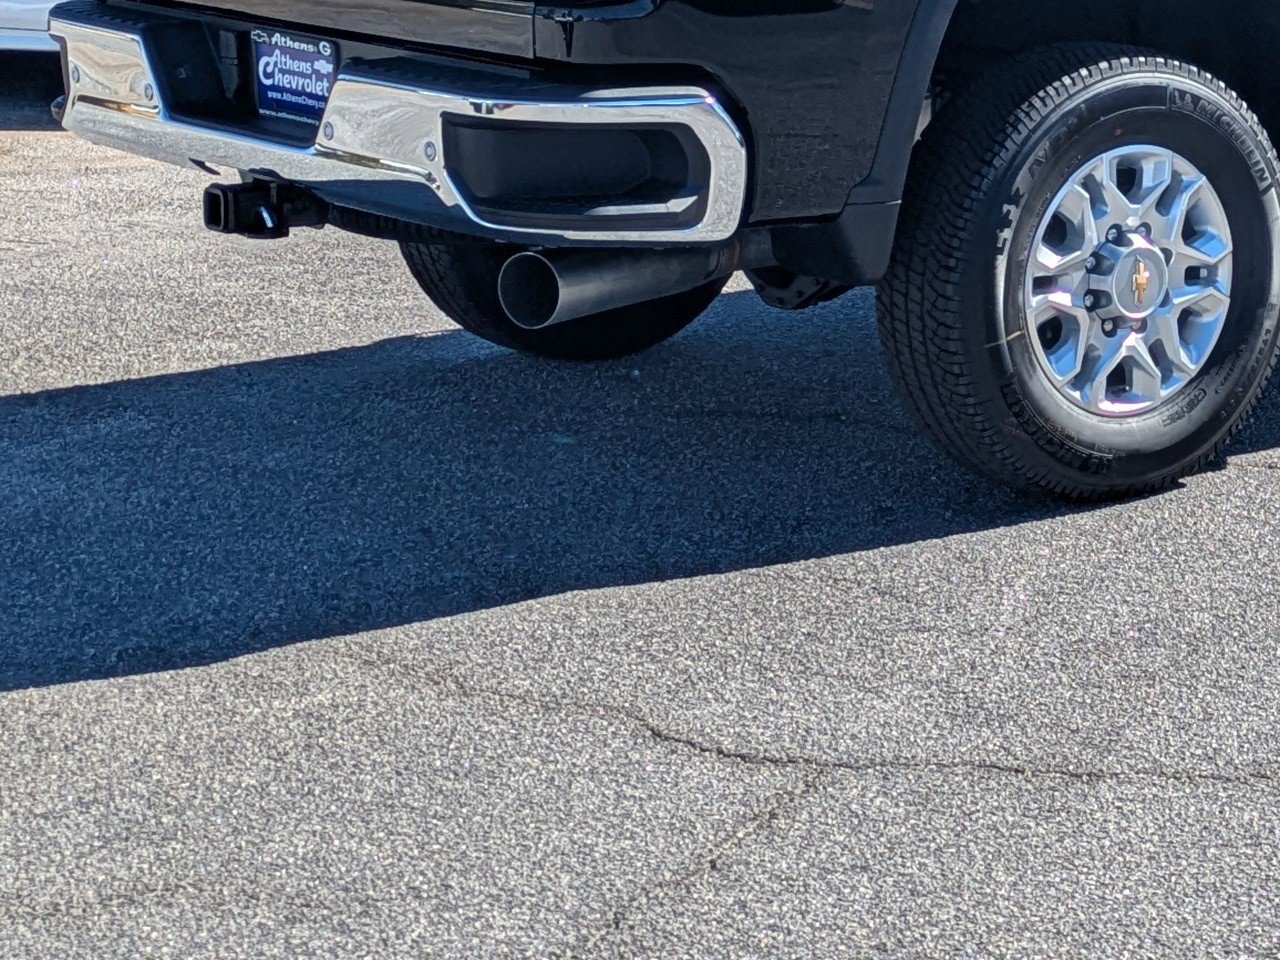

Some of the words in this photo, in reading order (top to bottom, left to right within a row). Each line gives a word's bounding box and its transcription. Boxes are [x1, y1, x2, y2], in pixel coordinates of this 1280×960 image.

[271, 32, 314, 52] Athens
[271, 48, 312, 74] Athens
[258, 55, 329, 96] Chevrolet
[267, 90, 325, 109] www.AthensChevy.co
[1197, 100, 1271, 190] MICHELIN
